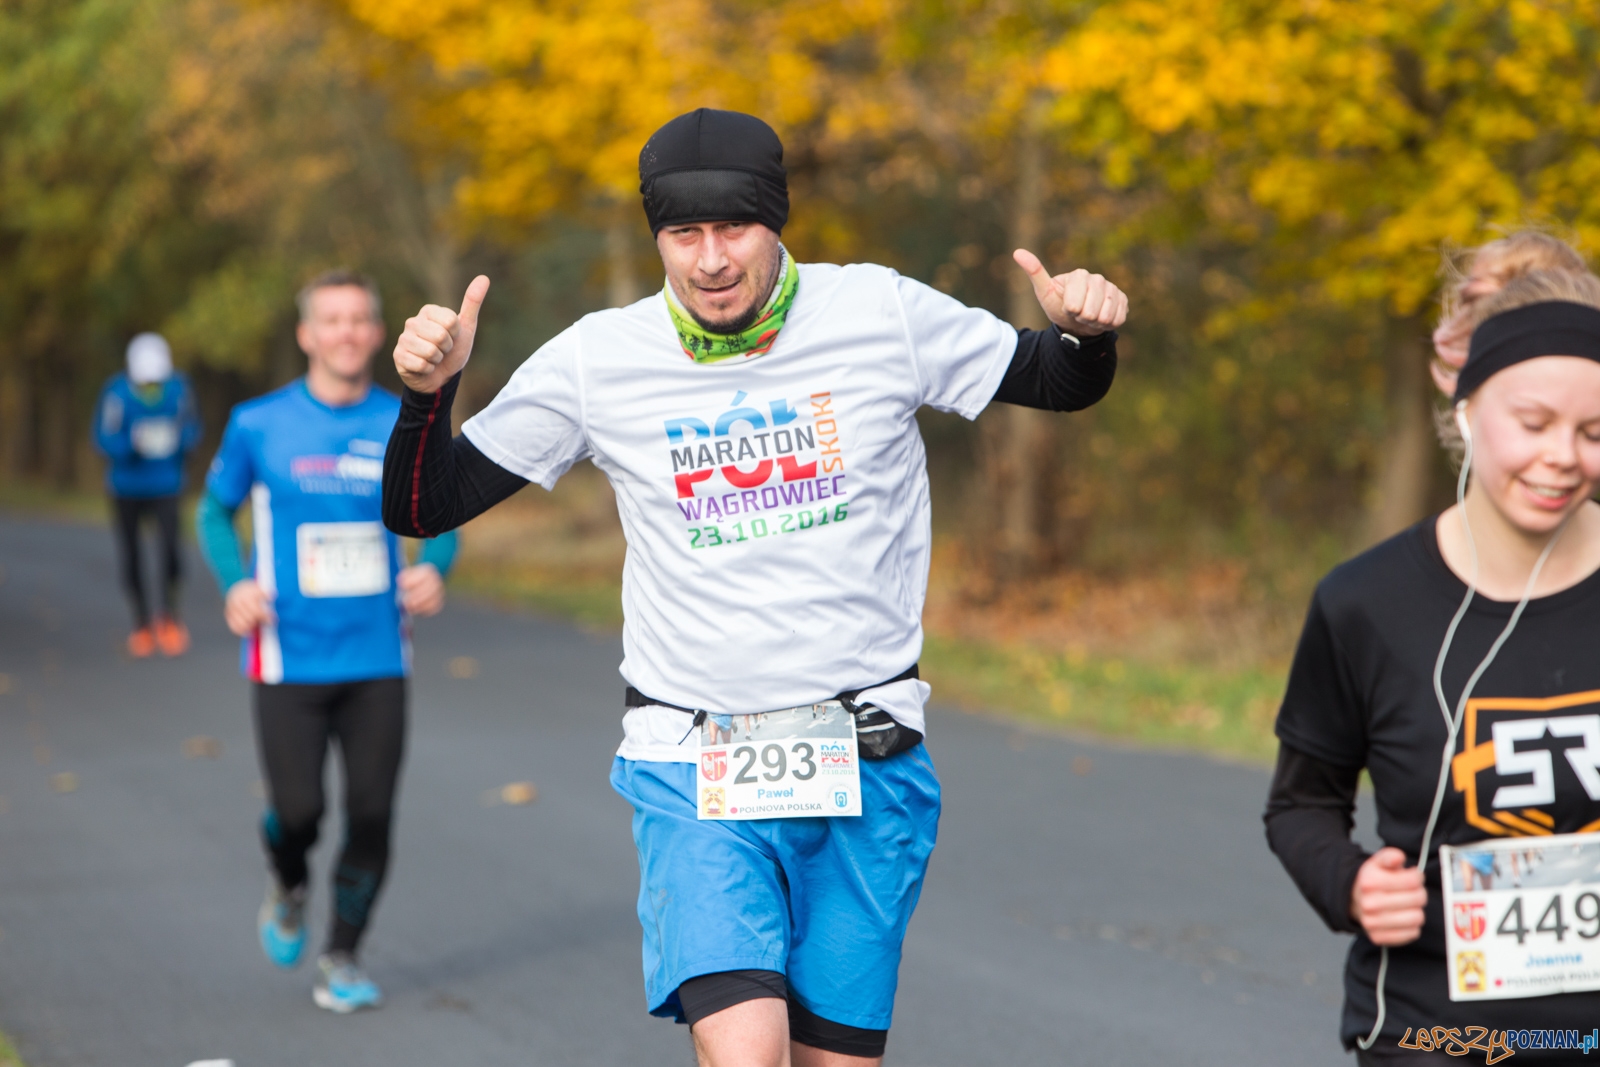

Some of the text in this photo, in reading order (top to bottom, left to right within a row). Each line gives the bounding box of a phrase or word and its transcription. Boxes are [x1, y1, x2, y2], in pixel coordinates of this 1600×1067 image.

[670, 425, 815, 472] MARATON
[810, 391, 844, 473] SKOKI
[676, 474, 847, 522] WĄGROWIEC
[688, 502, 849, 549] 23.10.2016
[733, 742, 817, 785] 293
[739, 803, 822, 814] POLINOVA POLSKA
[757, 787, 794, 799] Paweł
[1496, 892, 1600, 944] 449
